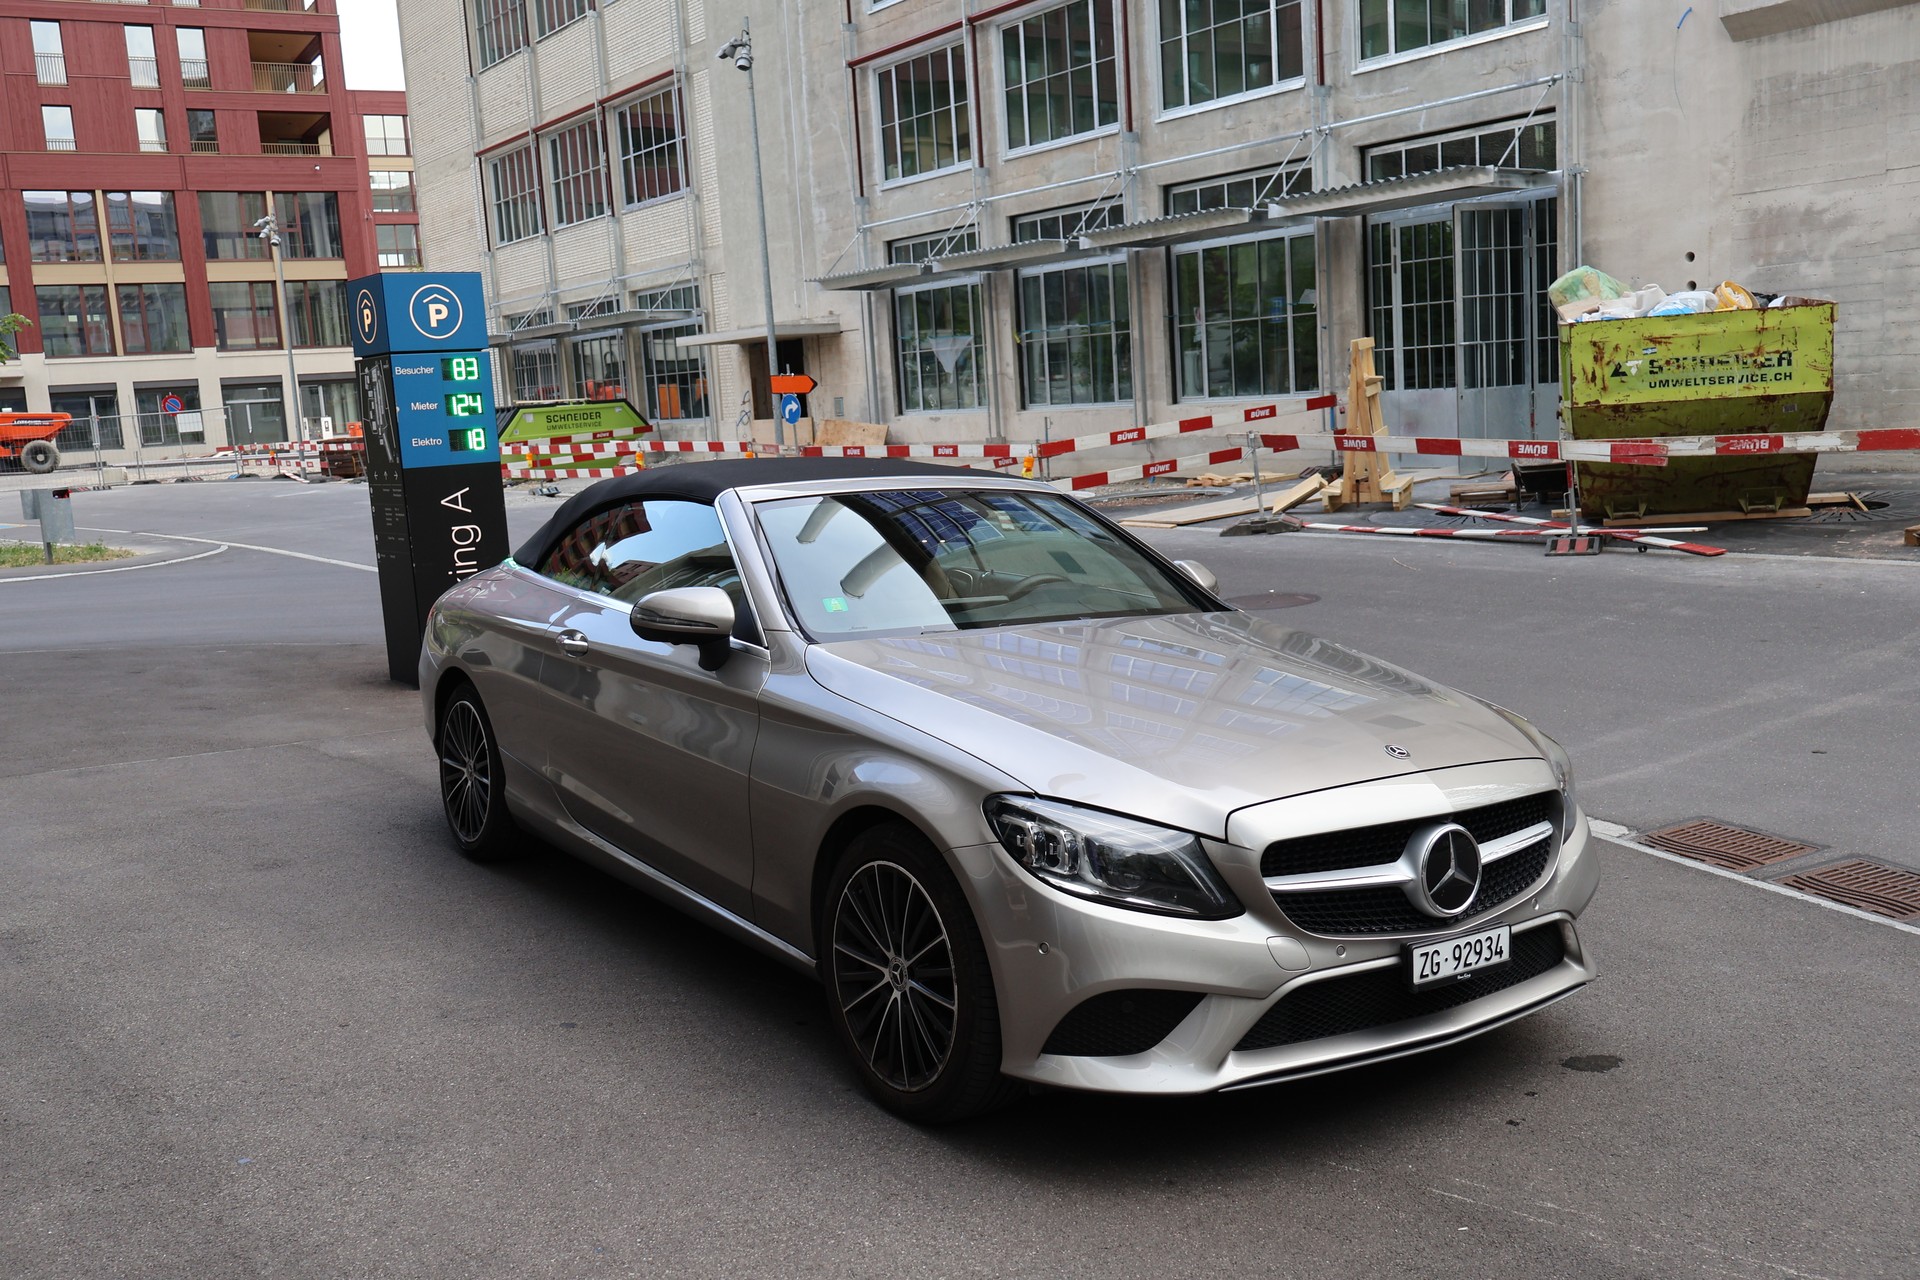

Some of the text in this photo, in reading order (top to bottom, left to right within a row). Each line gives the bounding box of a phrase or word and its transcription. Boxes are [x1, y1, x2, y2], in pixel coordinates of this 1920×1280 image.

[395, 366, 435, 376] Besucher
[452, 357, 479, 380] 83
[1649, 372, 1793, 389] UMWELTSERVICE.CH
[411, 402, 438, 411] Mieter
[451, 394, 483, 416] 124
[546, 411, 602, 423] SCHNEIDER
[1250, 408, 1270, 418] BÜWE
[546, 421, 602, 431] UMWELTSERVICE
[467, 428, 485, 451] 18
[1116, 431, 1139, 441] BÜWE
[412, 438, 442, 447] Elektro
[1343, 439, 1367, 449] BÜWE
[847, 447, 861, 456] BÜWE
[938, 446, 954, 455] BÜWE
[1518, 443, 1548, 457] BÜWE
[1149, 463, 1171, 474] BÜWE
[440, 487, 482, 582] ing A
